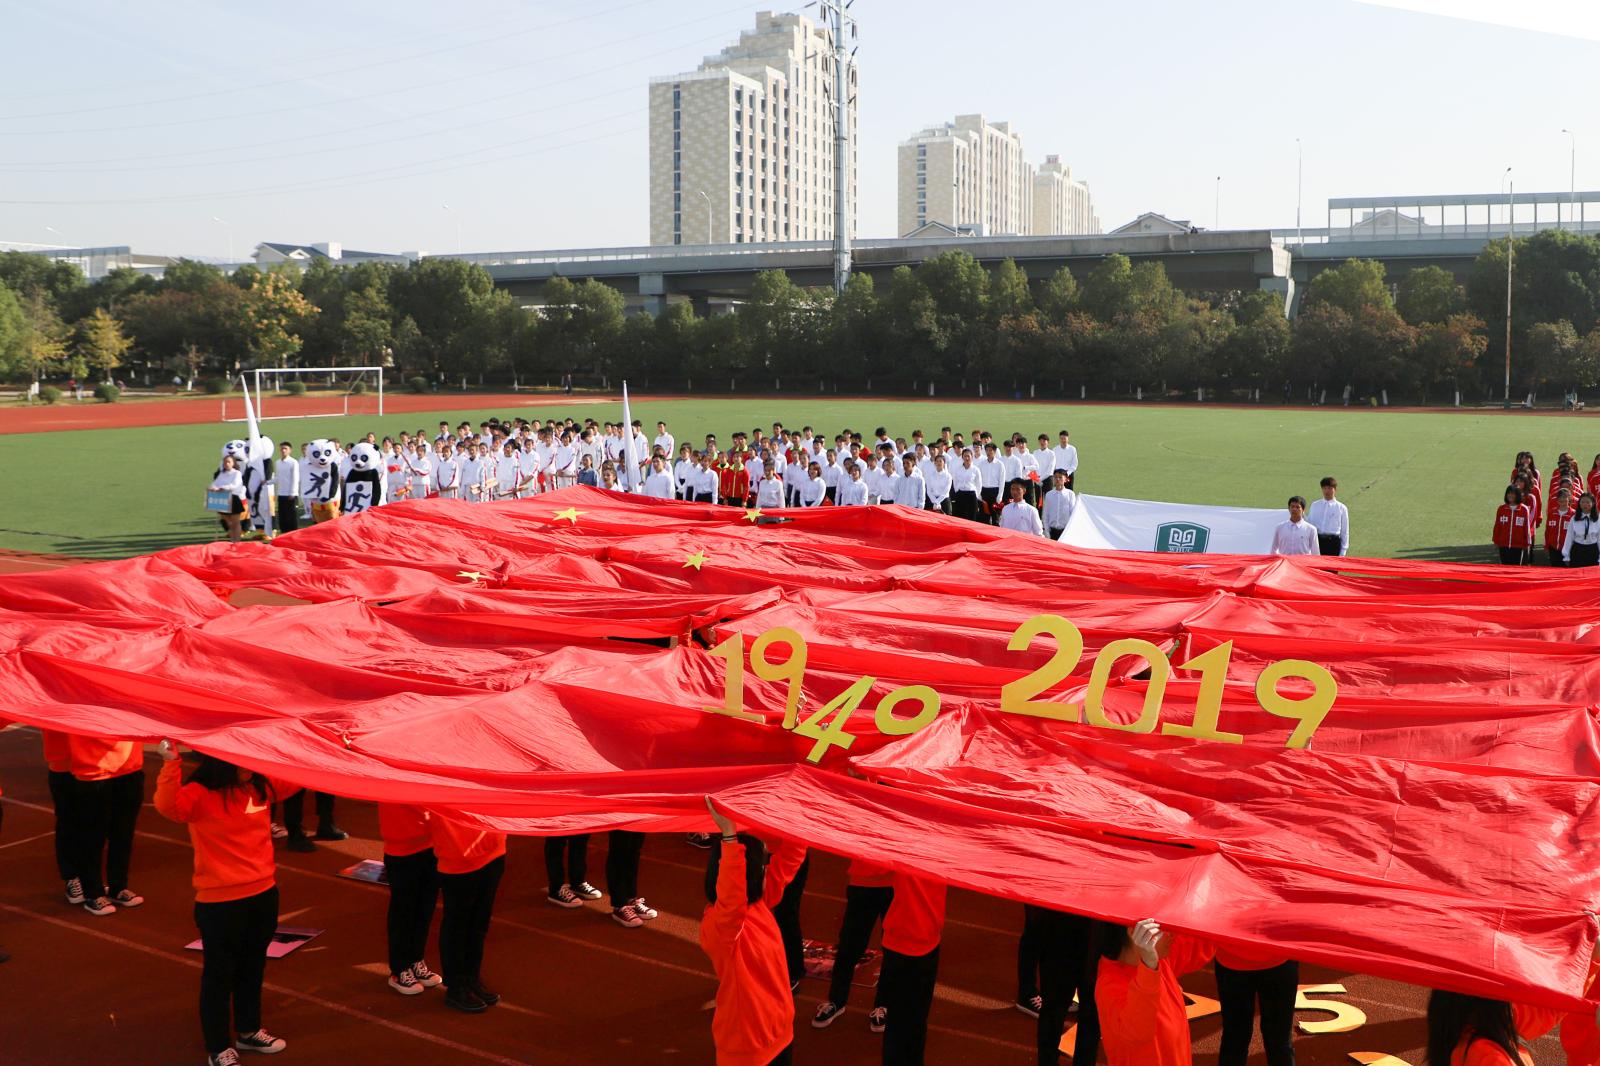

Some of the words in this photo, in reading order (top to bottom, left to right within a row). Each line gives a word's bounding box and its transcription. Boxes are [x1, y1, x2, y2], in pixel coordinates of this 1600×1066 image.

[703, 626, 941, 765] 1940
[1000, 613, 1338, 749] 2019
[1295, 983, 1367, 1034] 5
